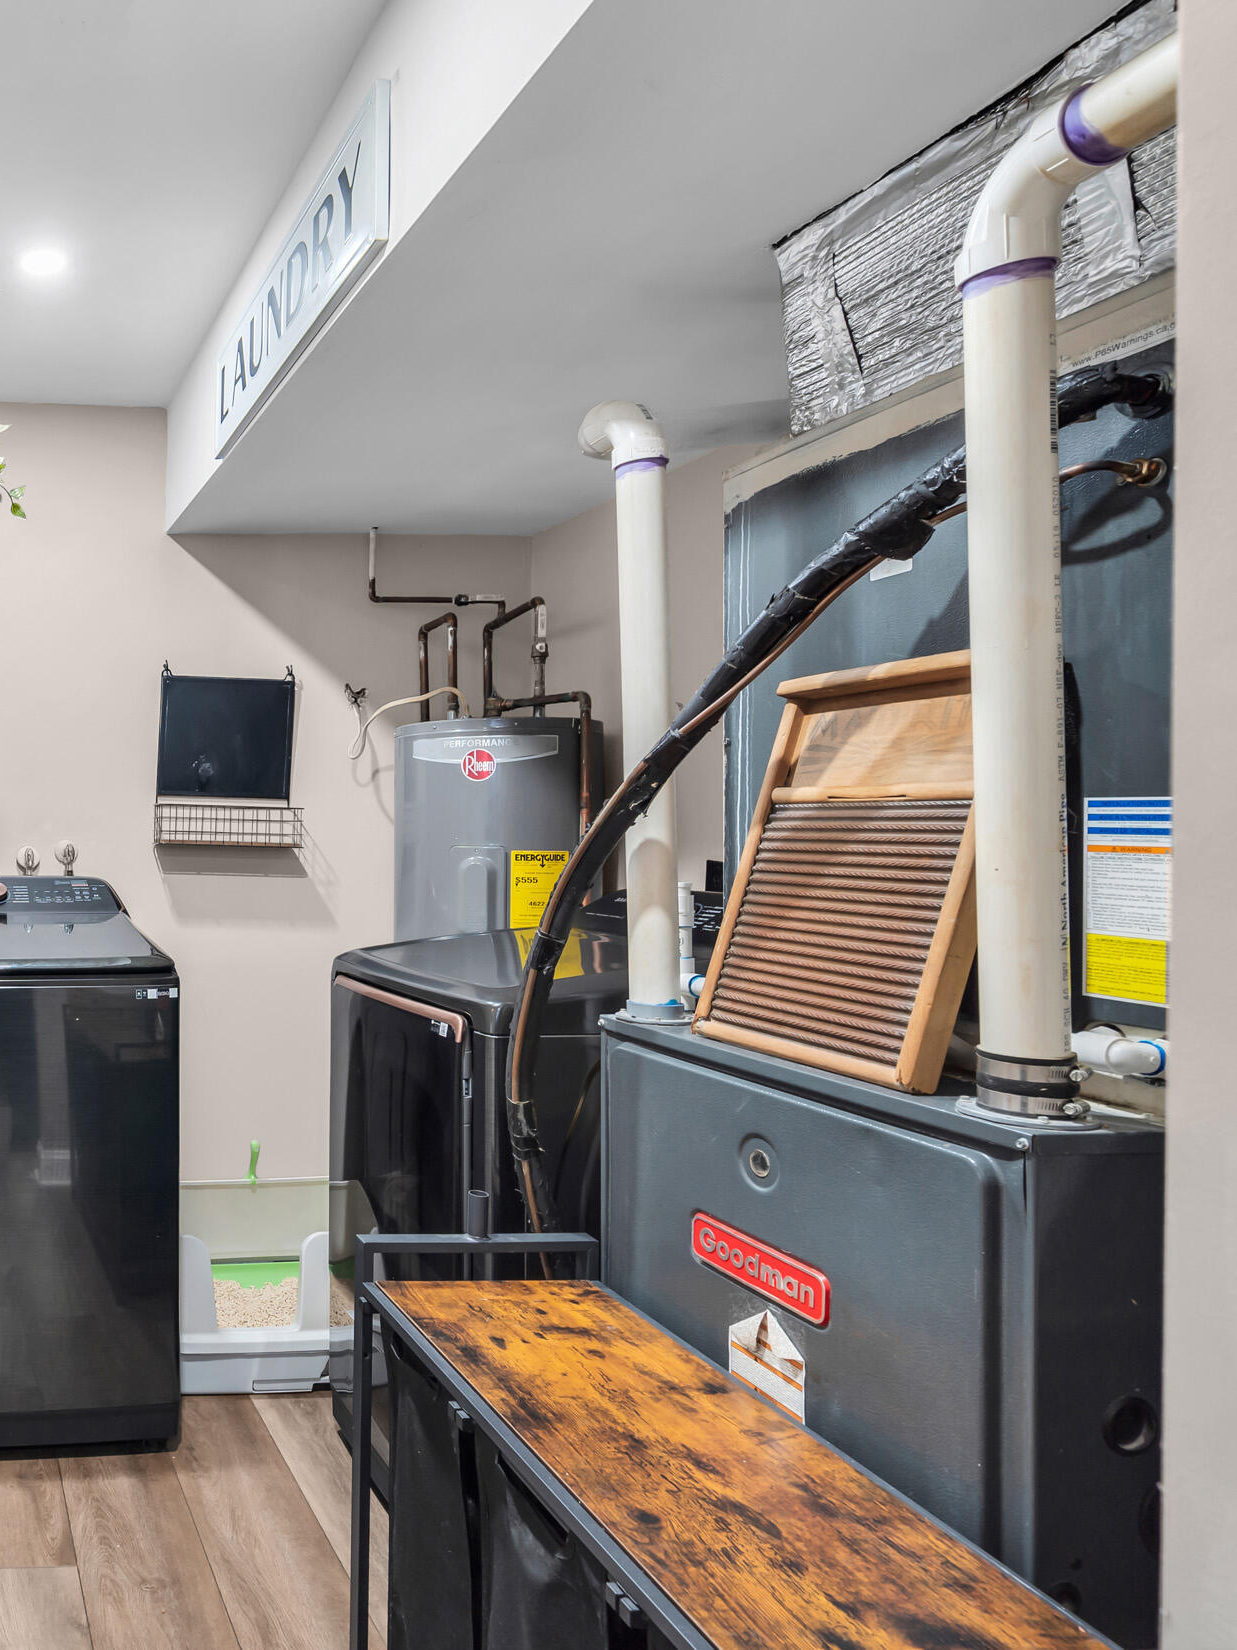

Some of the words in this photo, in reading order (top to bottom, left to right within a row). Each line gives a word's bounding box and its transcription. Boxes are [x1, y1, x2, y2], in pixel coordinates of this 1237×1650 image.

[220, 139, 362, 424] LAUNDRY
[443, 738, 513, 749] PERFORMANC
[465, 749, 494, 776] Rheem
[515, 876, 539, 884] $555
[699, 1227, 815, 1309] Goodman
